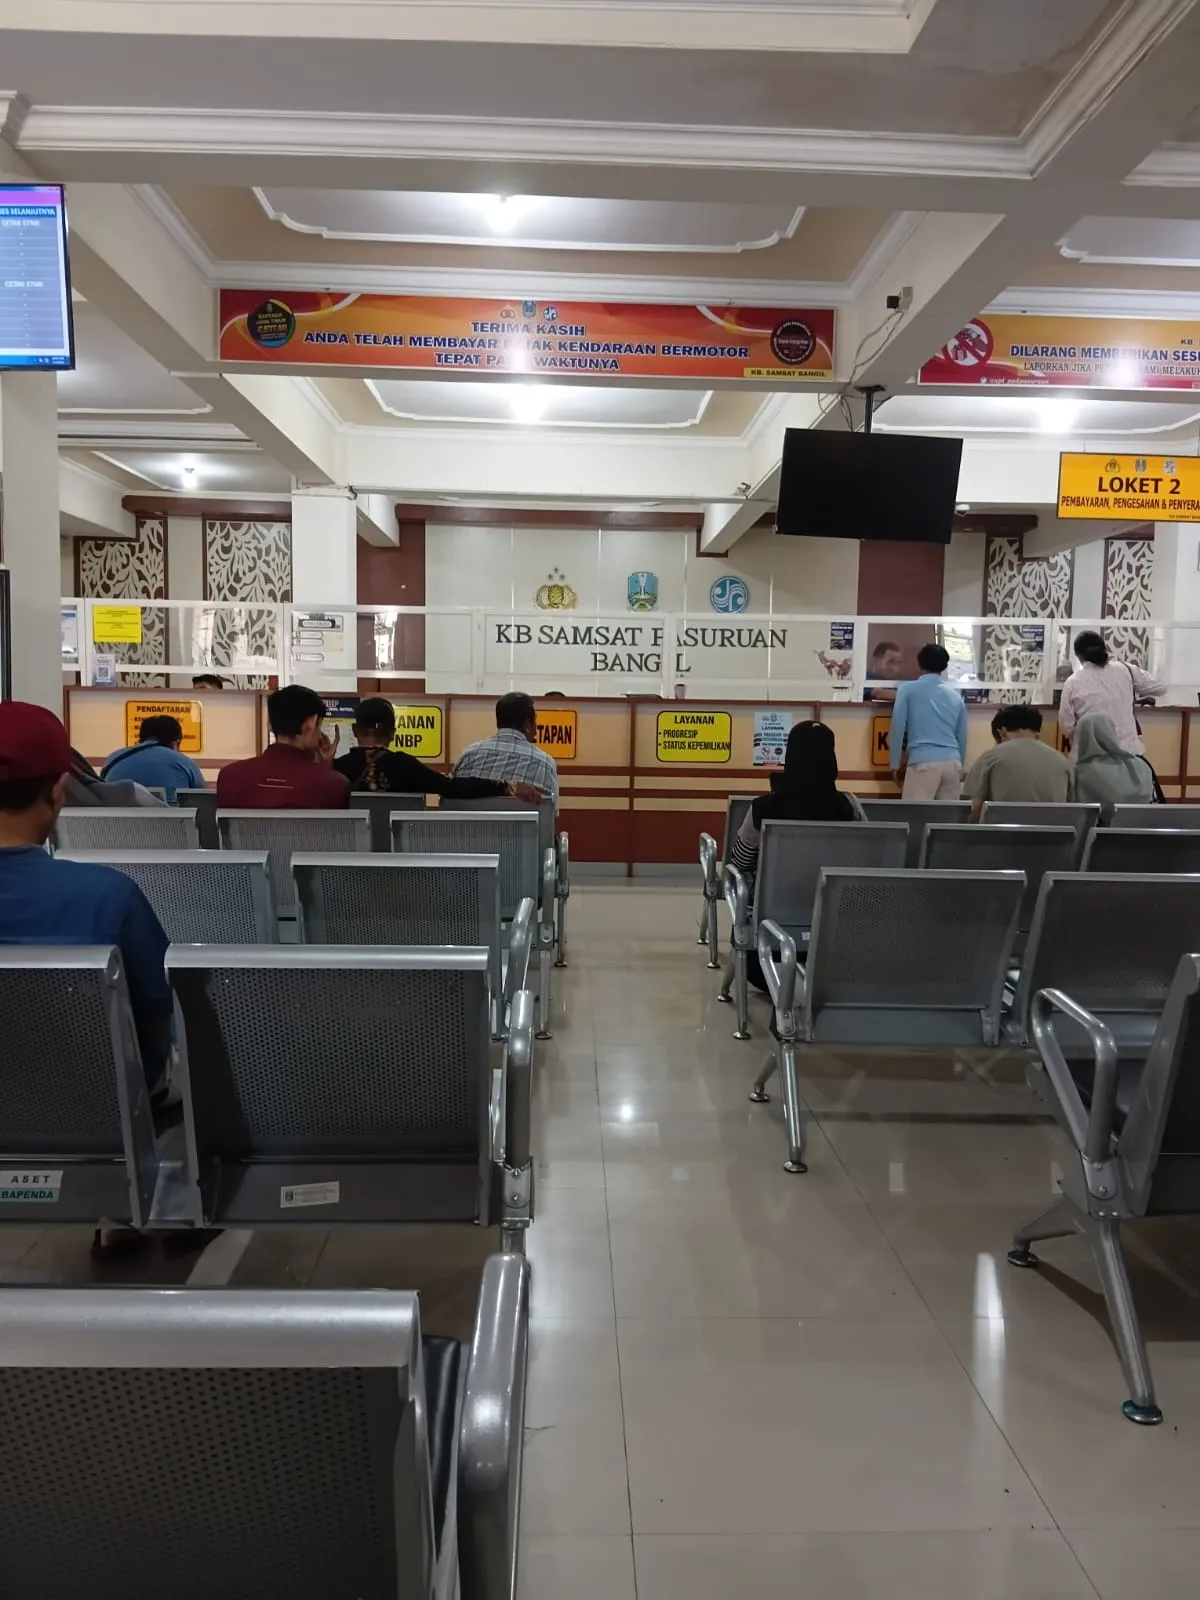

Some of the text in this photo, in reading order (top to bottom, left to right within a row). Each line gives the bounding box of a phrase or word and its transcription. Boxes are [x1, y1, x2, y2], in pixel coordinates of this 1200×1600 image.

[471, 322, 586, 336] TERIMA KASIH
[304, 332, 349, 344] ANDA
[354, 333, 404, 346] TELAH
[409, 336, 497, 349] MEMBAYAR
[558, 341, 656, 356] KENDARAAN
[661, 344, 749, 358] BERMOTOR
[1010, 345, 1076, 358] DILARANG
[1081, 347, 1168, 361] MEMBERIKAN
[434, 352, 480, 366] TEPAT
[534, 356, 619, 370] WAKTUNYA
[1024, 362, 1069, 372] LAPORKAN
[1072, 364, 1091, 373] JIKA
[1098, 476, 1181, 494] LOKET 2
[1061, 496, 1111, 509] PEMBAYARAN,
[1113, 498, 1160, 509] PENGESAHAN
[496, 624, 532, 644] KB
[538, 625, 643, 646] SAMSAT
[591, 652, 691, 673] BANGL
[136, 705, 191, 713] PENDAFTARAN
[674, 715, 715, 725] LAYANAN
[663, 729, 698, 739] PROGRESIP
[663, 740, 730, 751] STATUS KEPEMILIKAN
[10, 1175, 51, 1184] ASET
[1, 1190, 54, 1199] BAPENDA
